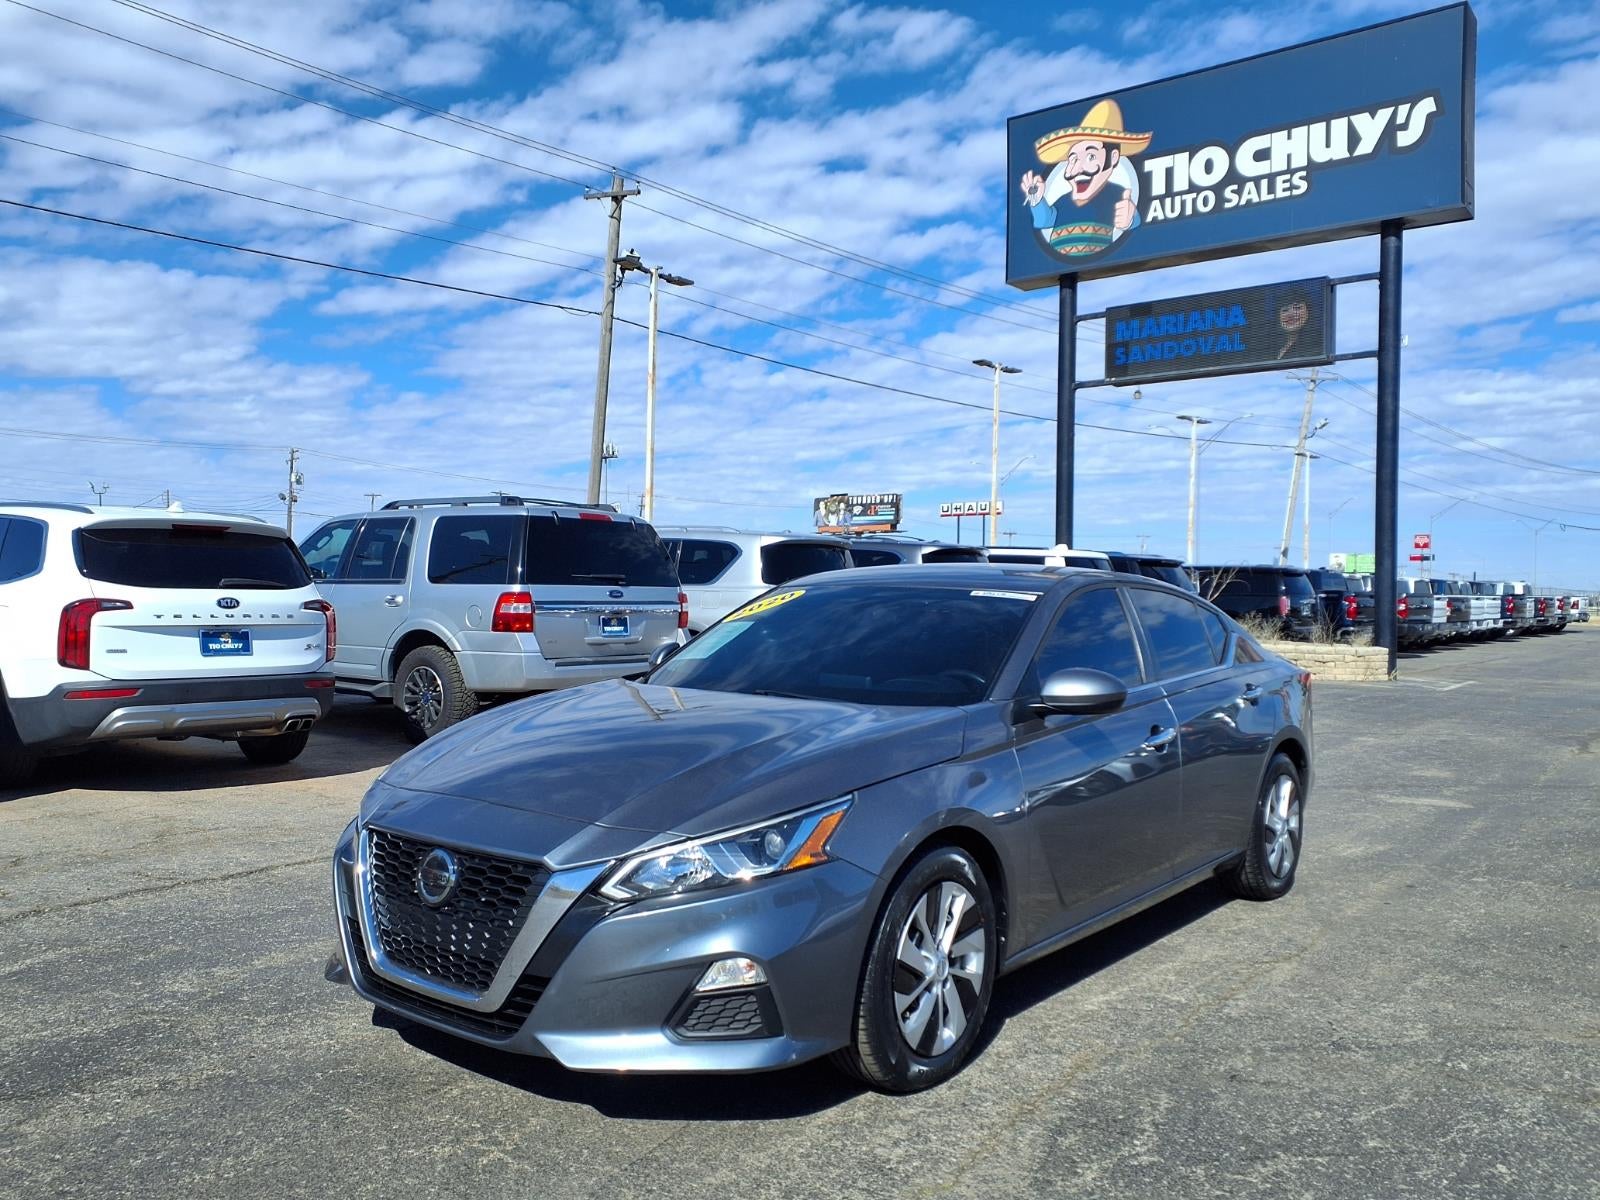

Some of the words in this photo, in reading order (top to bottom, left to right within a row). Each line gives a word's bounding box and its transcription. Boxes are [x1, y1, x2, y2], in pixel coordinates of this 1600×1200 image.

[1144, 145, 1230, 196] TIO
[1235, 96, 1437, 177] CHUY'S
[1146, 190, 1216, 223] AUTO
[1224, 170, 1308, 209] SALES
[1115, 303, 1247, 342] MARIANA
[1115, 331, 1246, 366] SANDOVAL
[218, 598, 238, 607] KIA
